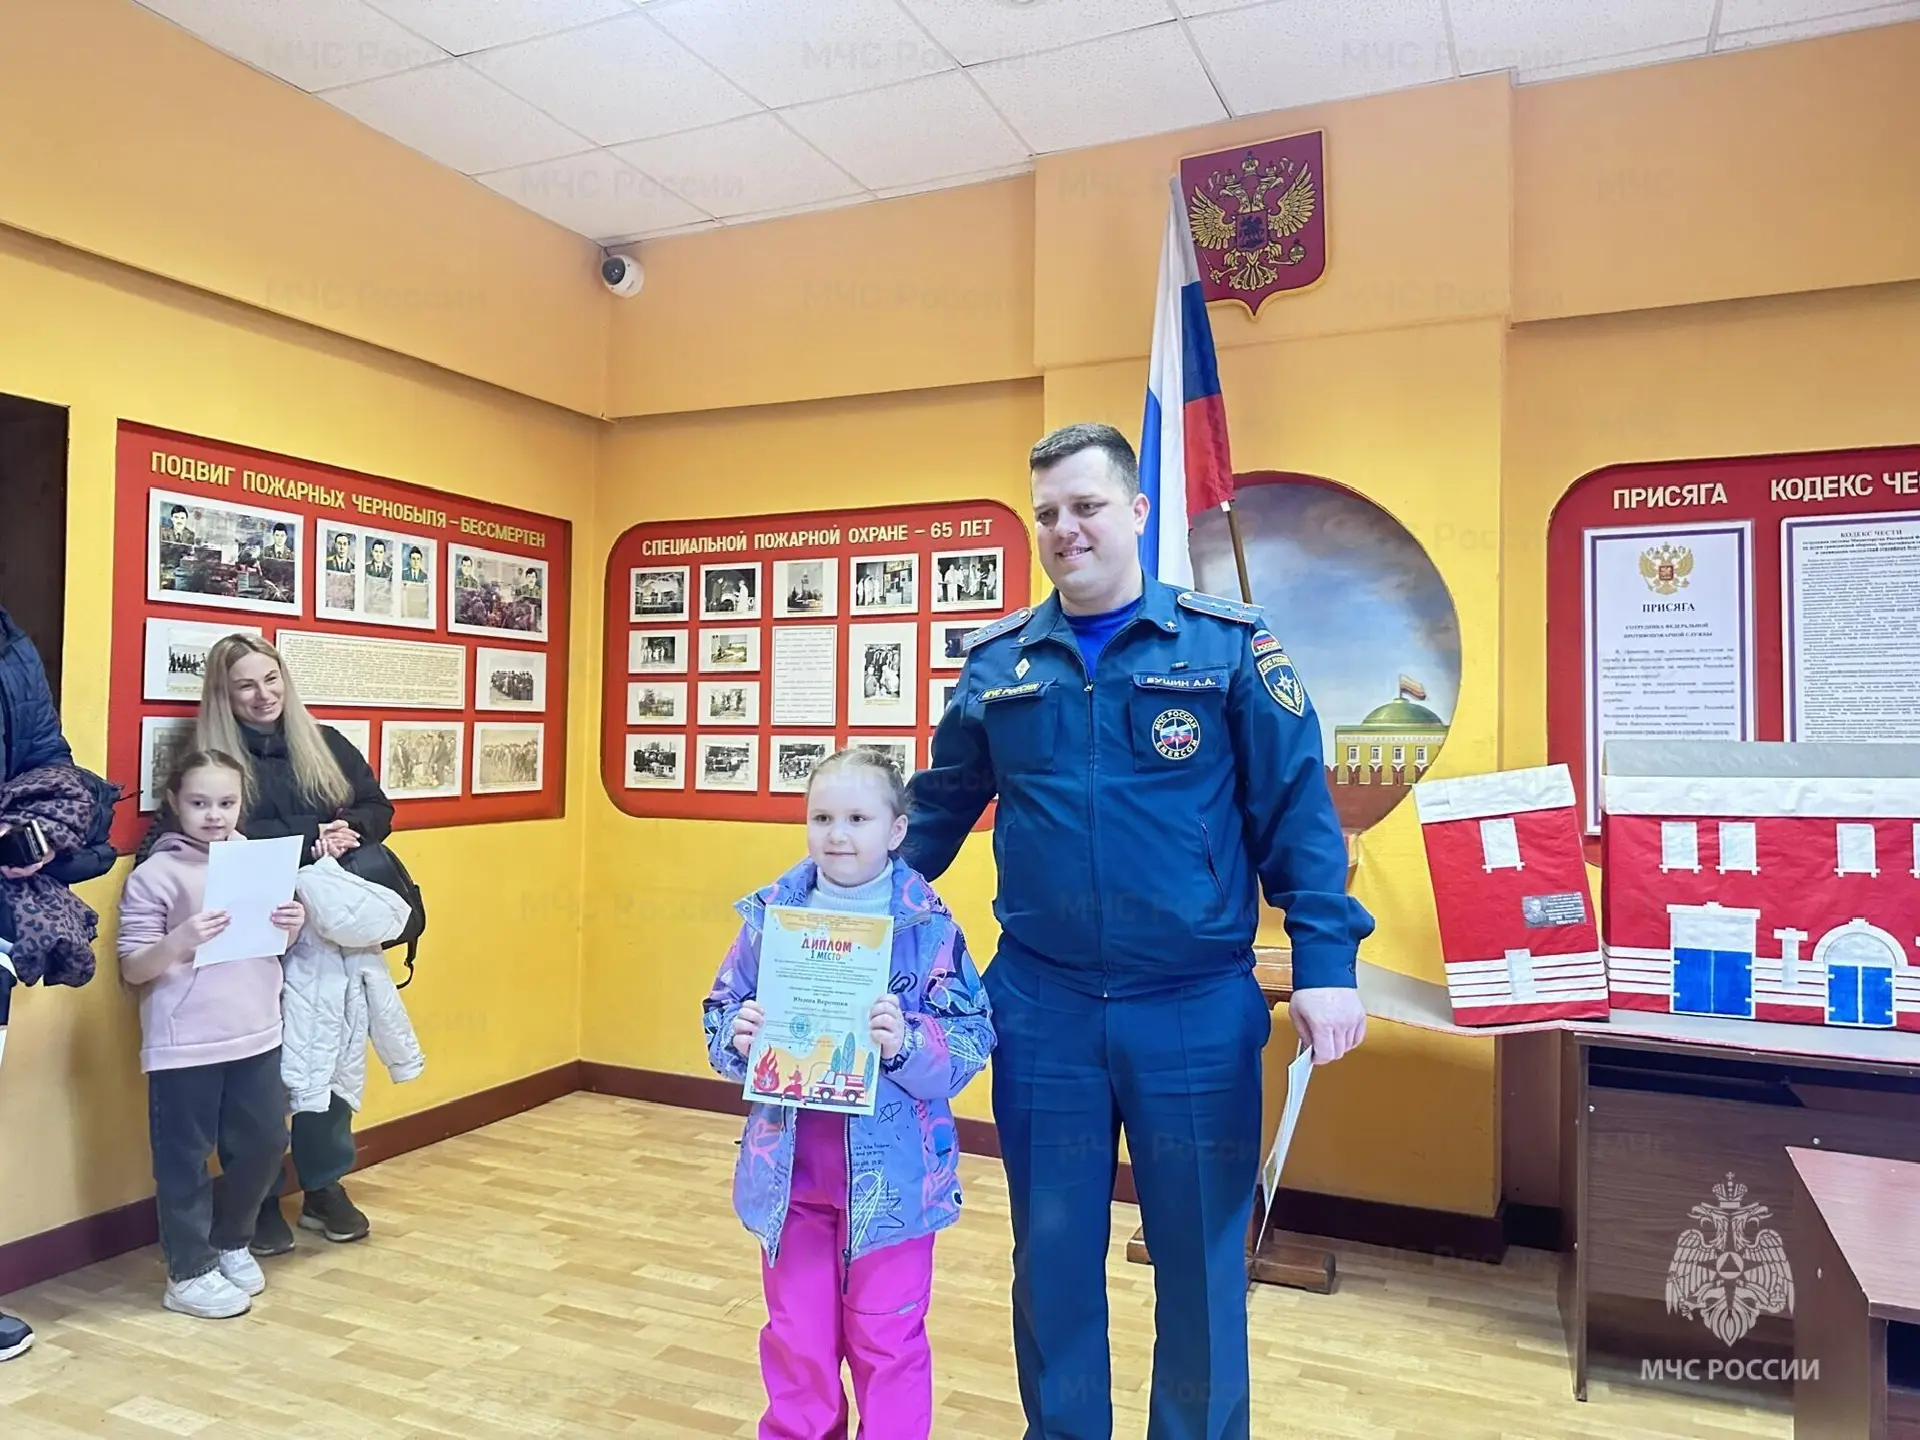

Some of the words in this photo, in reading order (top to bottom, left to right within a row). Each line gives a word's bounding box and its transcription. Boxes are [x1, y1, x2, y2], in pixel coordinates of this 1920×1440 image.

[1613, 483, 1728, 509] ПРИСЯГА
[1770, 474, 1873, 502] КОДЕКС
[1882, 471, 1920, 495] ЧЕ
[151, 451, 236, 486] ПОДВИГ
[242, 470, 346, 509] ПОЖАРНЫХ
[351, 493, 446, 528] ЧЕРНОБЫЛЯ
[460, 516, 546, 547] БЕССМЕРТЕН
[642, 531, 747, 556] СПЕЦИАЛЬНОЙ
[754, 524, 840, 550] ПОЖАРНОЙ
[848, 524, 908, 543] ОХРАНЕ
[931, 521, 953, 538] 65
[960, 519, 992, 537] ЛЕТ
[1642, 602, 1695, 612] ПРИСЯГА
[1154, 714, 1167, 730] МЧС
[1167, 710, 1198, 729] РОССИИ
[1156, 739, 1199, 758] EMERCOM
[801, 937, 852, 953] ДИПЛОМ
[817, 951, 841, 961] МЕСТО
